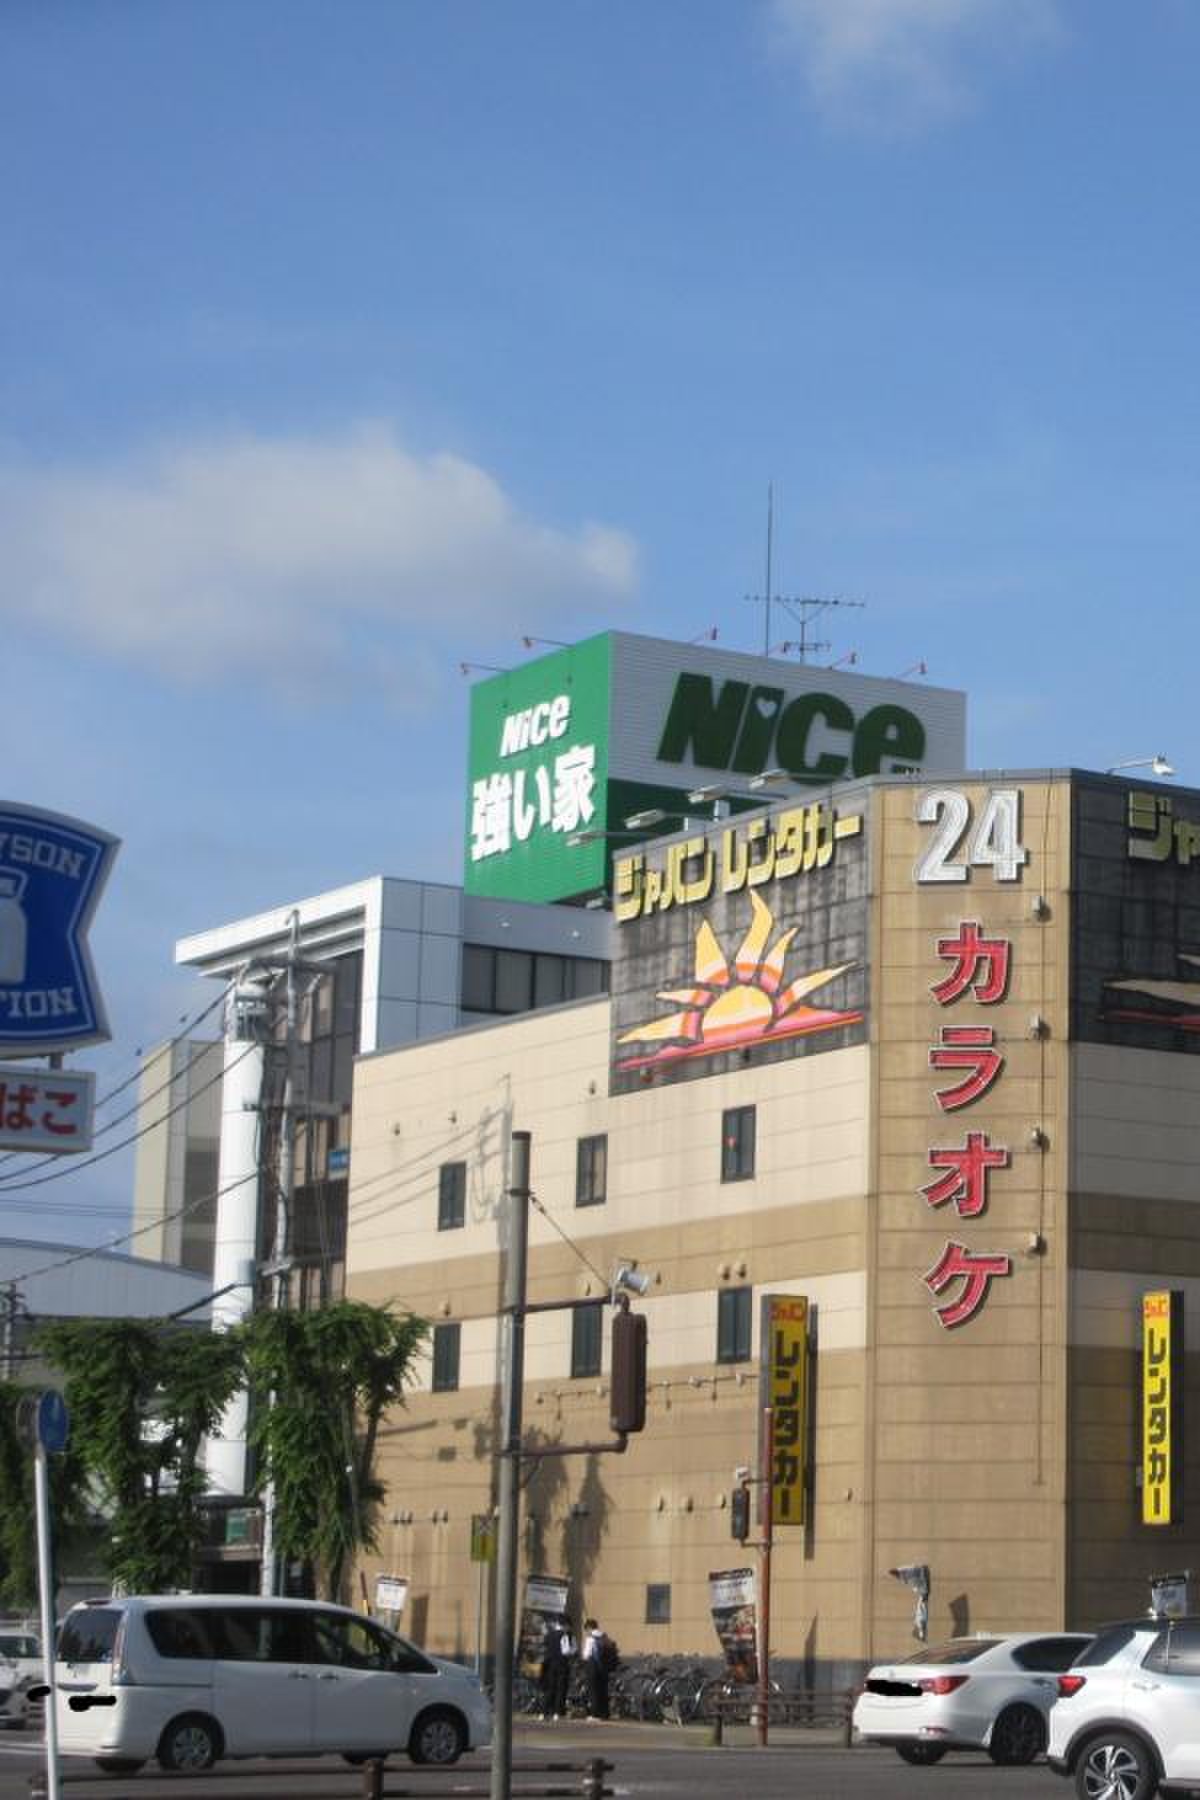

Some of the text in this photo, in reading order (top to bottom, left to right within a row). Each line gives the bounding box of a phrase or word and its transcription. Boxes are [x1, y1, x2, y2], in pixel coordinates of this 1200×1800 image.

[0, 832, 86, 879] SON
[471, 744, 597, 862] 強い家
[613, 802, 862, 923] ジャパン レンタカー
[915, 787, 1030, 884] 24
[918, 920, 1012, 1329] カラオケ
[771, 1330, 799, 1516] レンタカー
[1148, 1327, 1167, 1516] レンタカー
